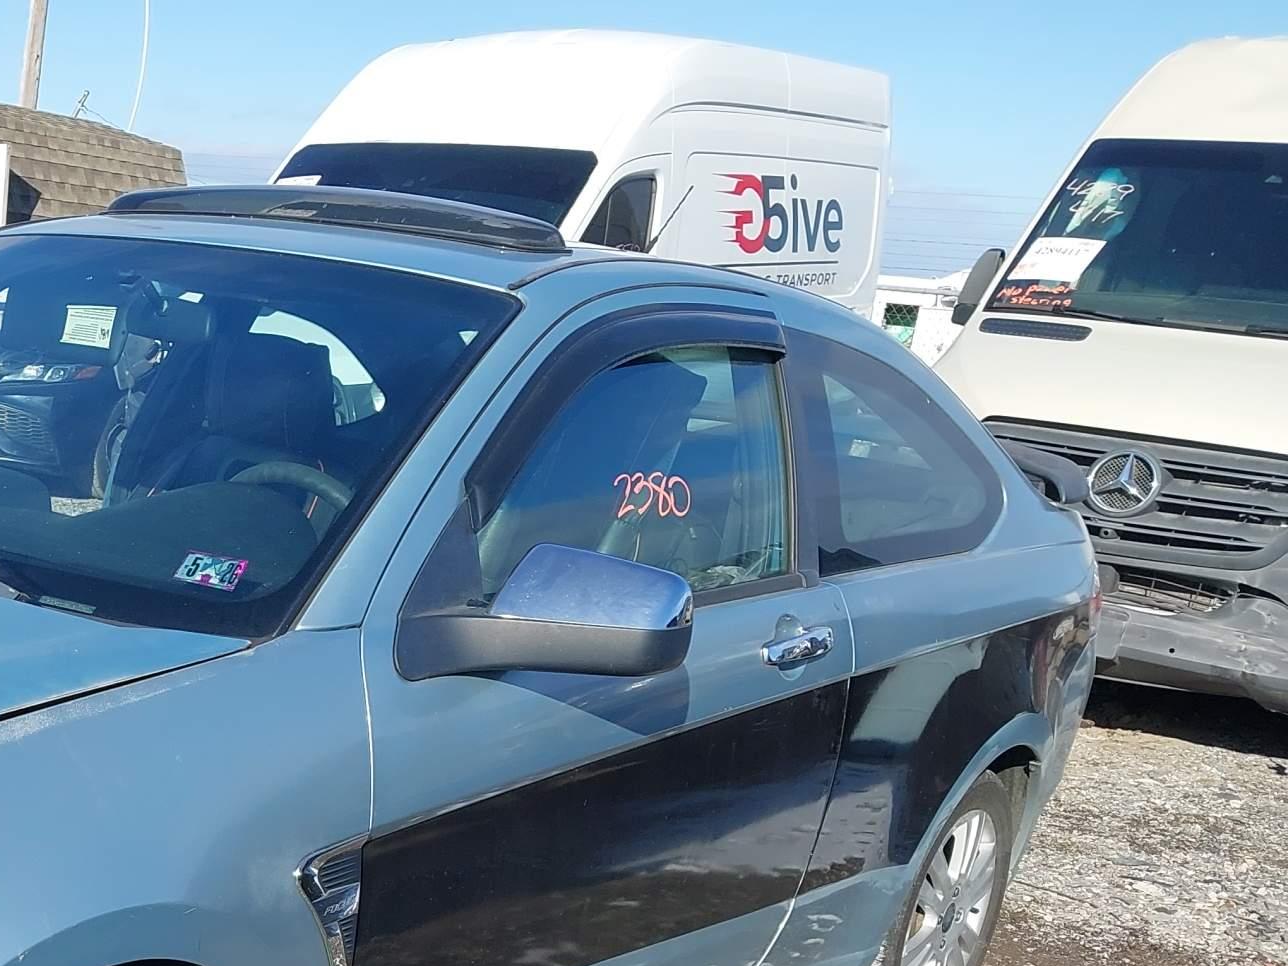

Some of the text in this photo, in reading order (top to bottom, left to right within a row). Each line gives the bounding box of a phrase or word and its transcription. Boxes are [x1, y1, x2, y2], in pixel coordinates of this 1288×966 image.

[1069, 200, 1124, 223] 417
[777, 272, 837, 287] TRANSPORT
[614, 472, 691, 518] 2380
